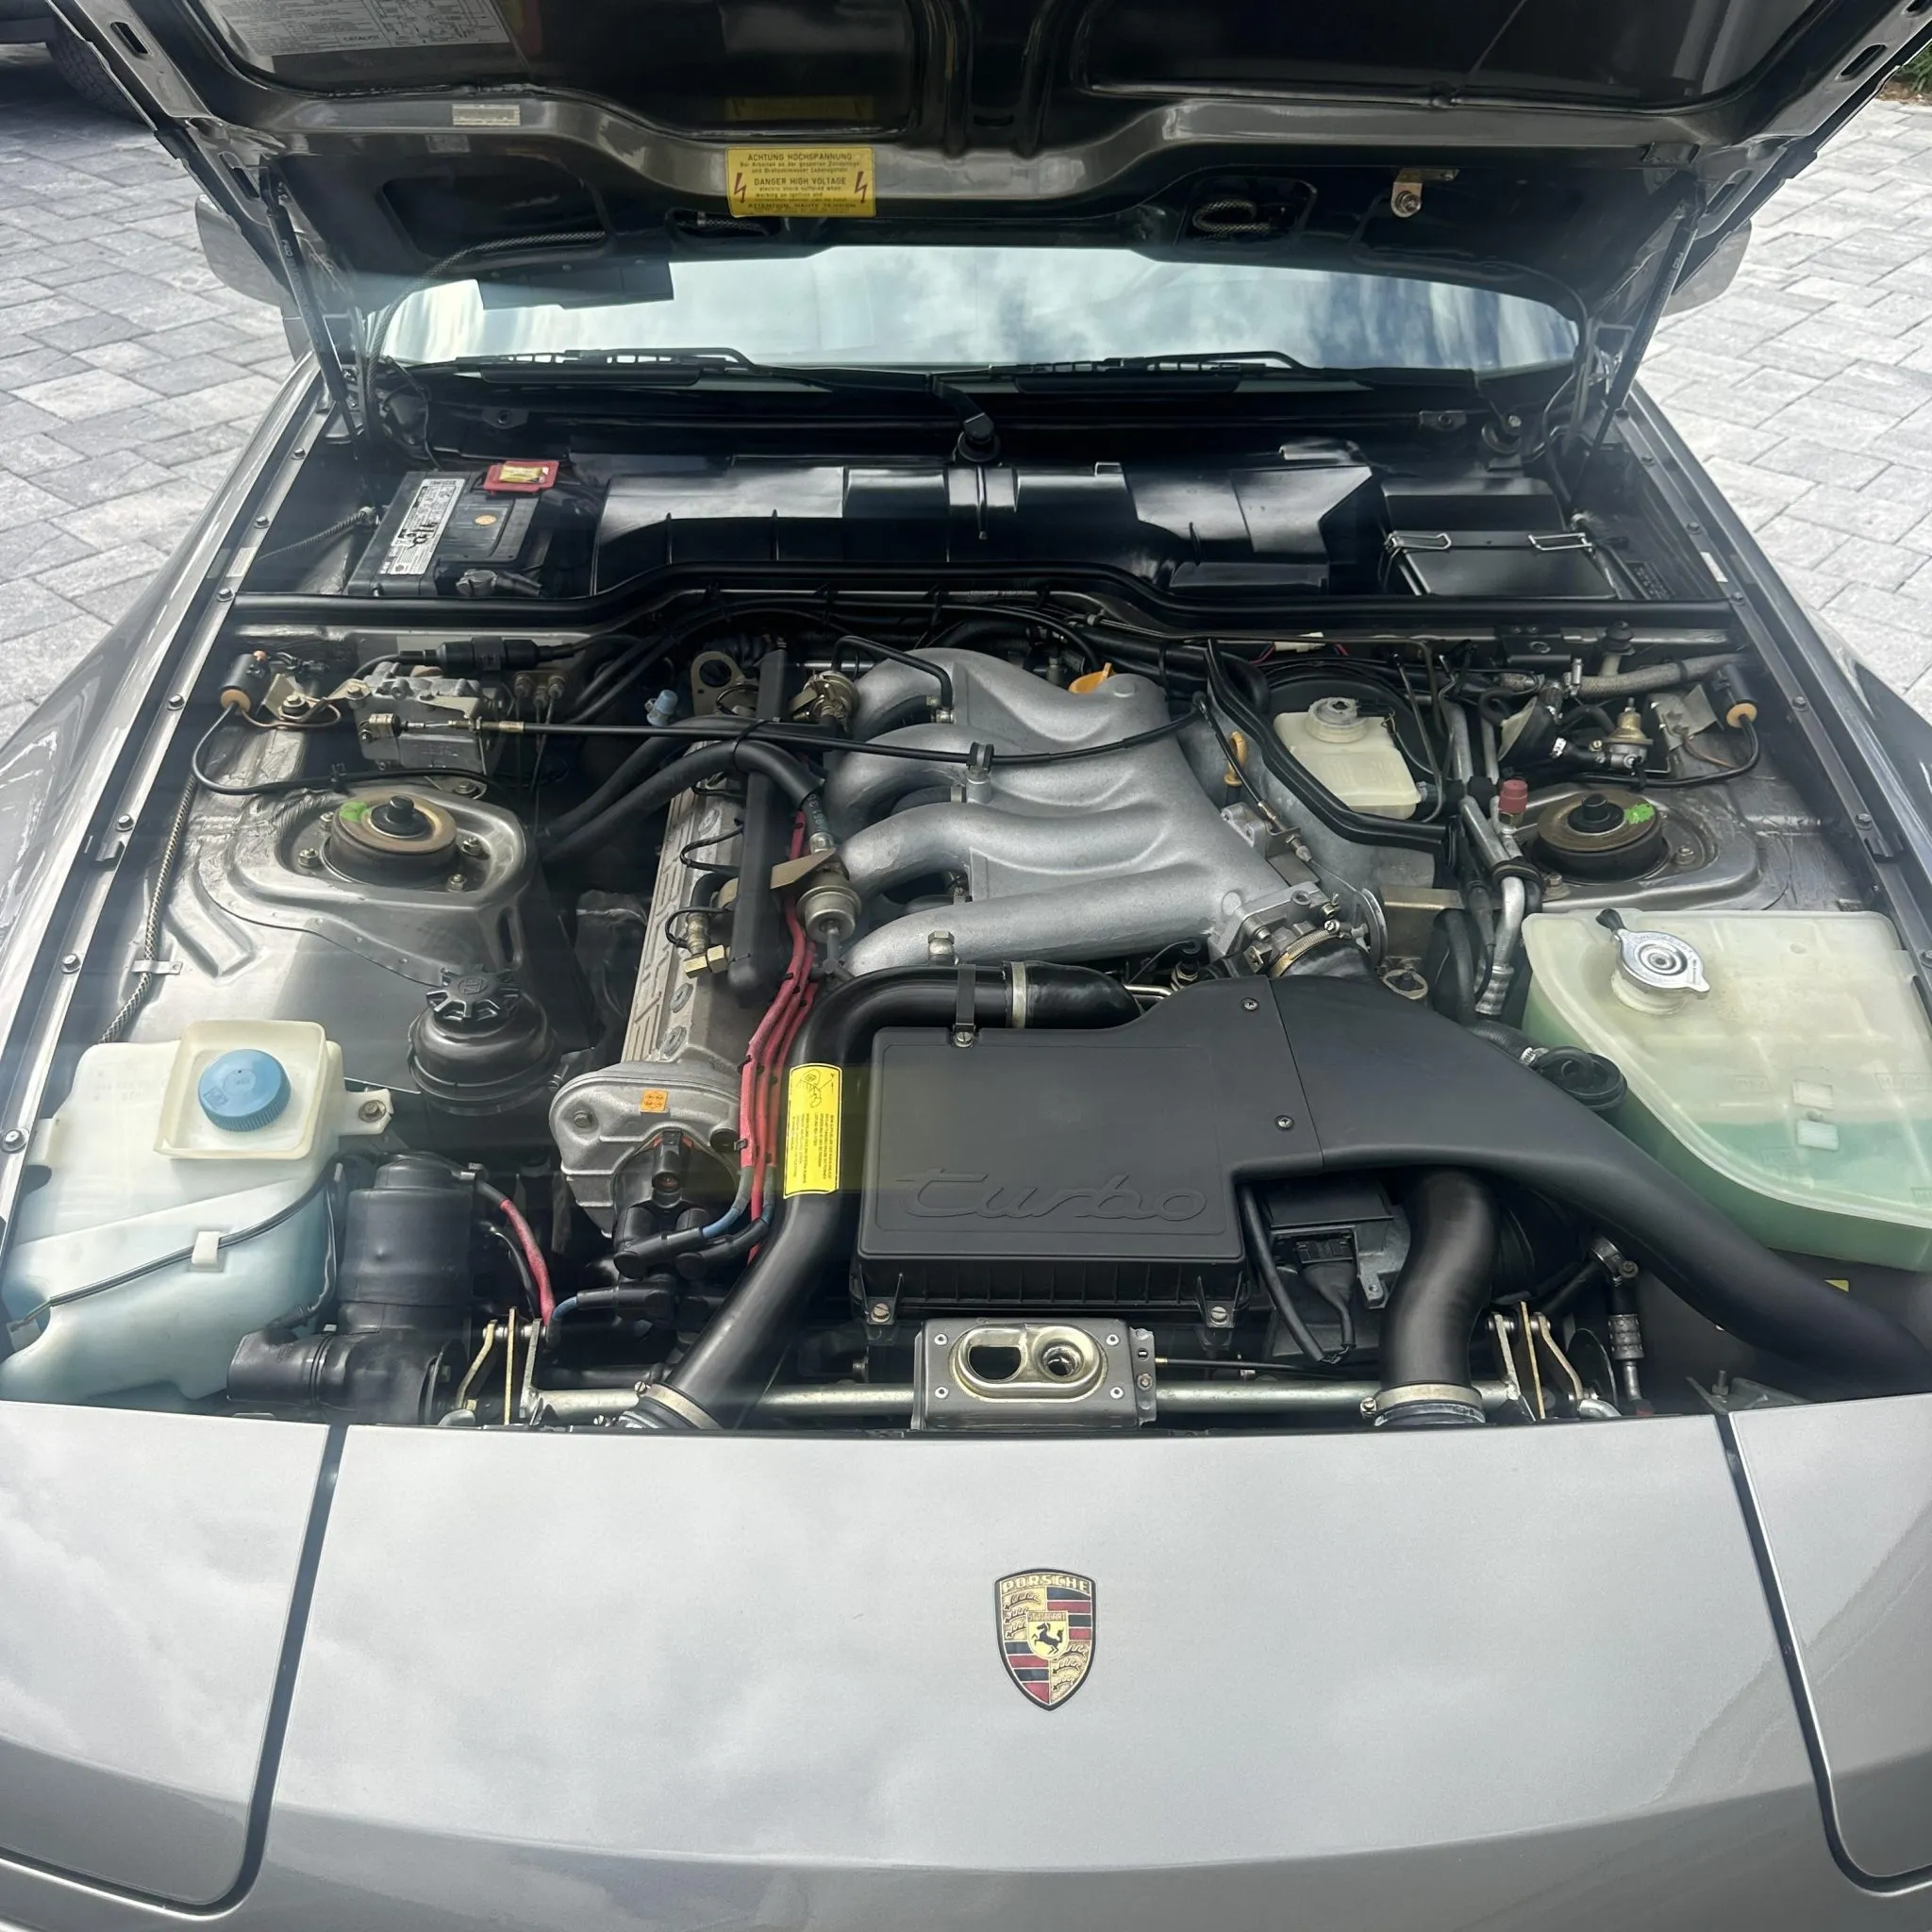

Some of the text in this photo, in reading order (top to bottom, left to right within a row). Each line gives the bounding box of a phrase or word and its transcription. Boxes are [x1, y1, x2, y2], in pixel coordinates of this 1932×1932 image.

[747, 153, 852, 161] ACHTUNG HOCHSPANNUNG
[754, 177, 846, 186] DANGER HIGH VOLTAGE
[1002, 1574, 1089, 1592] PORSCHE
